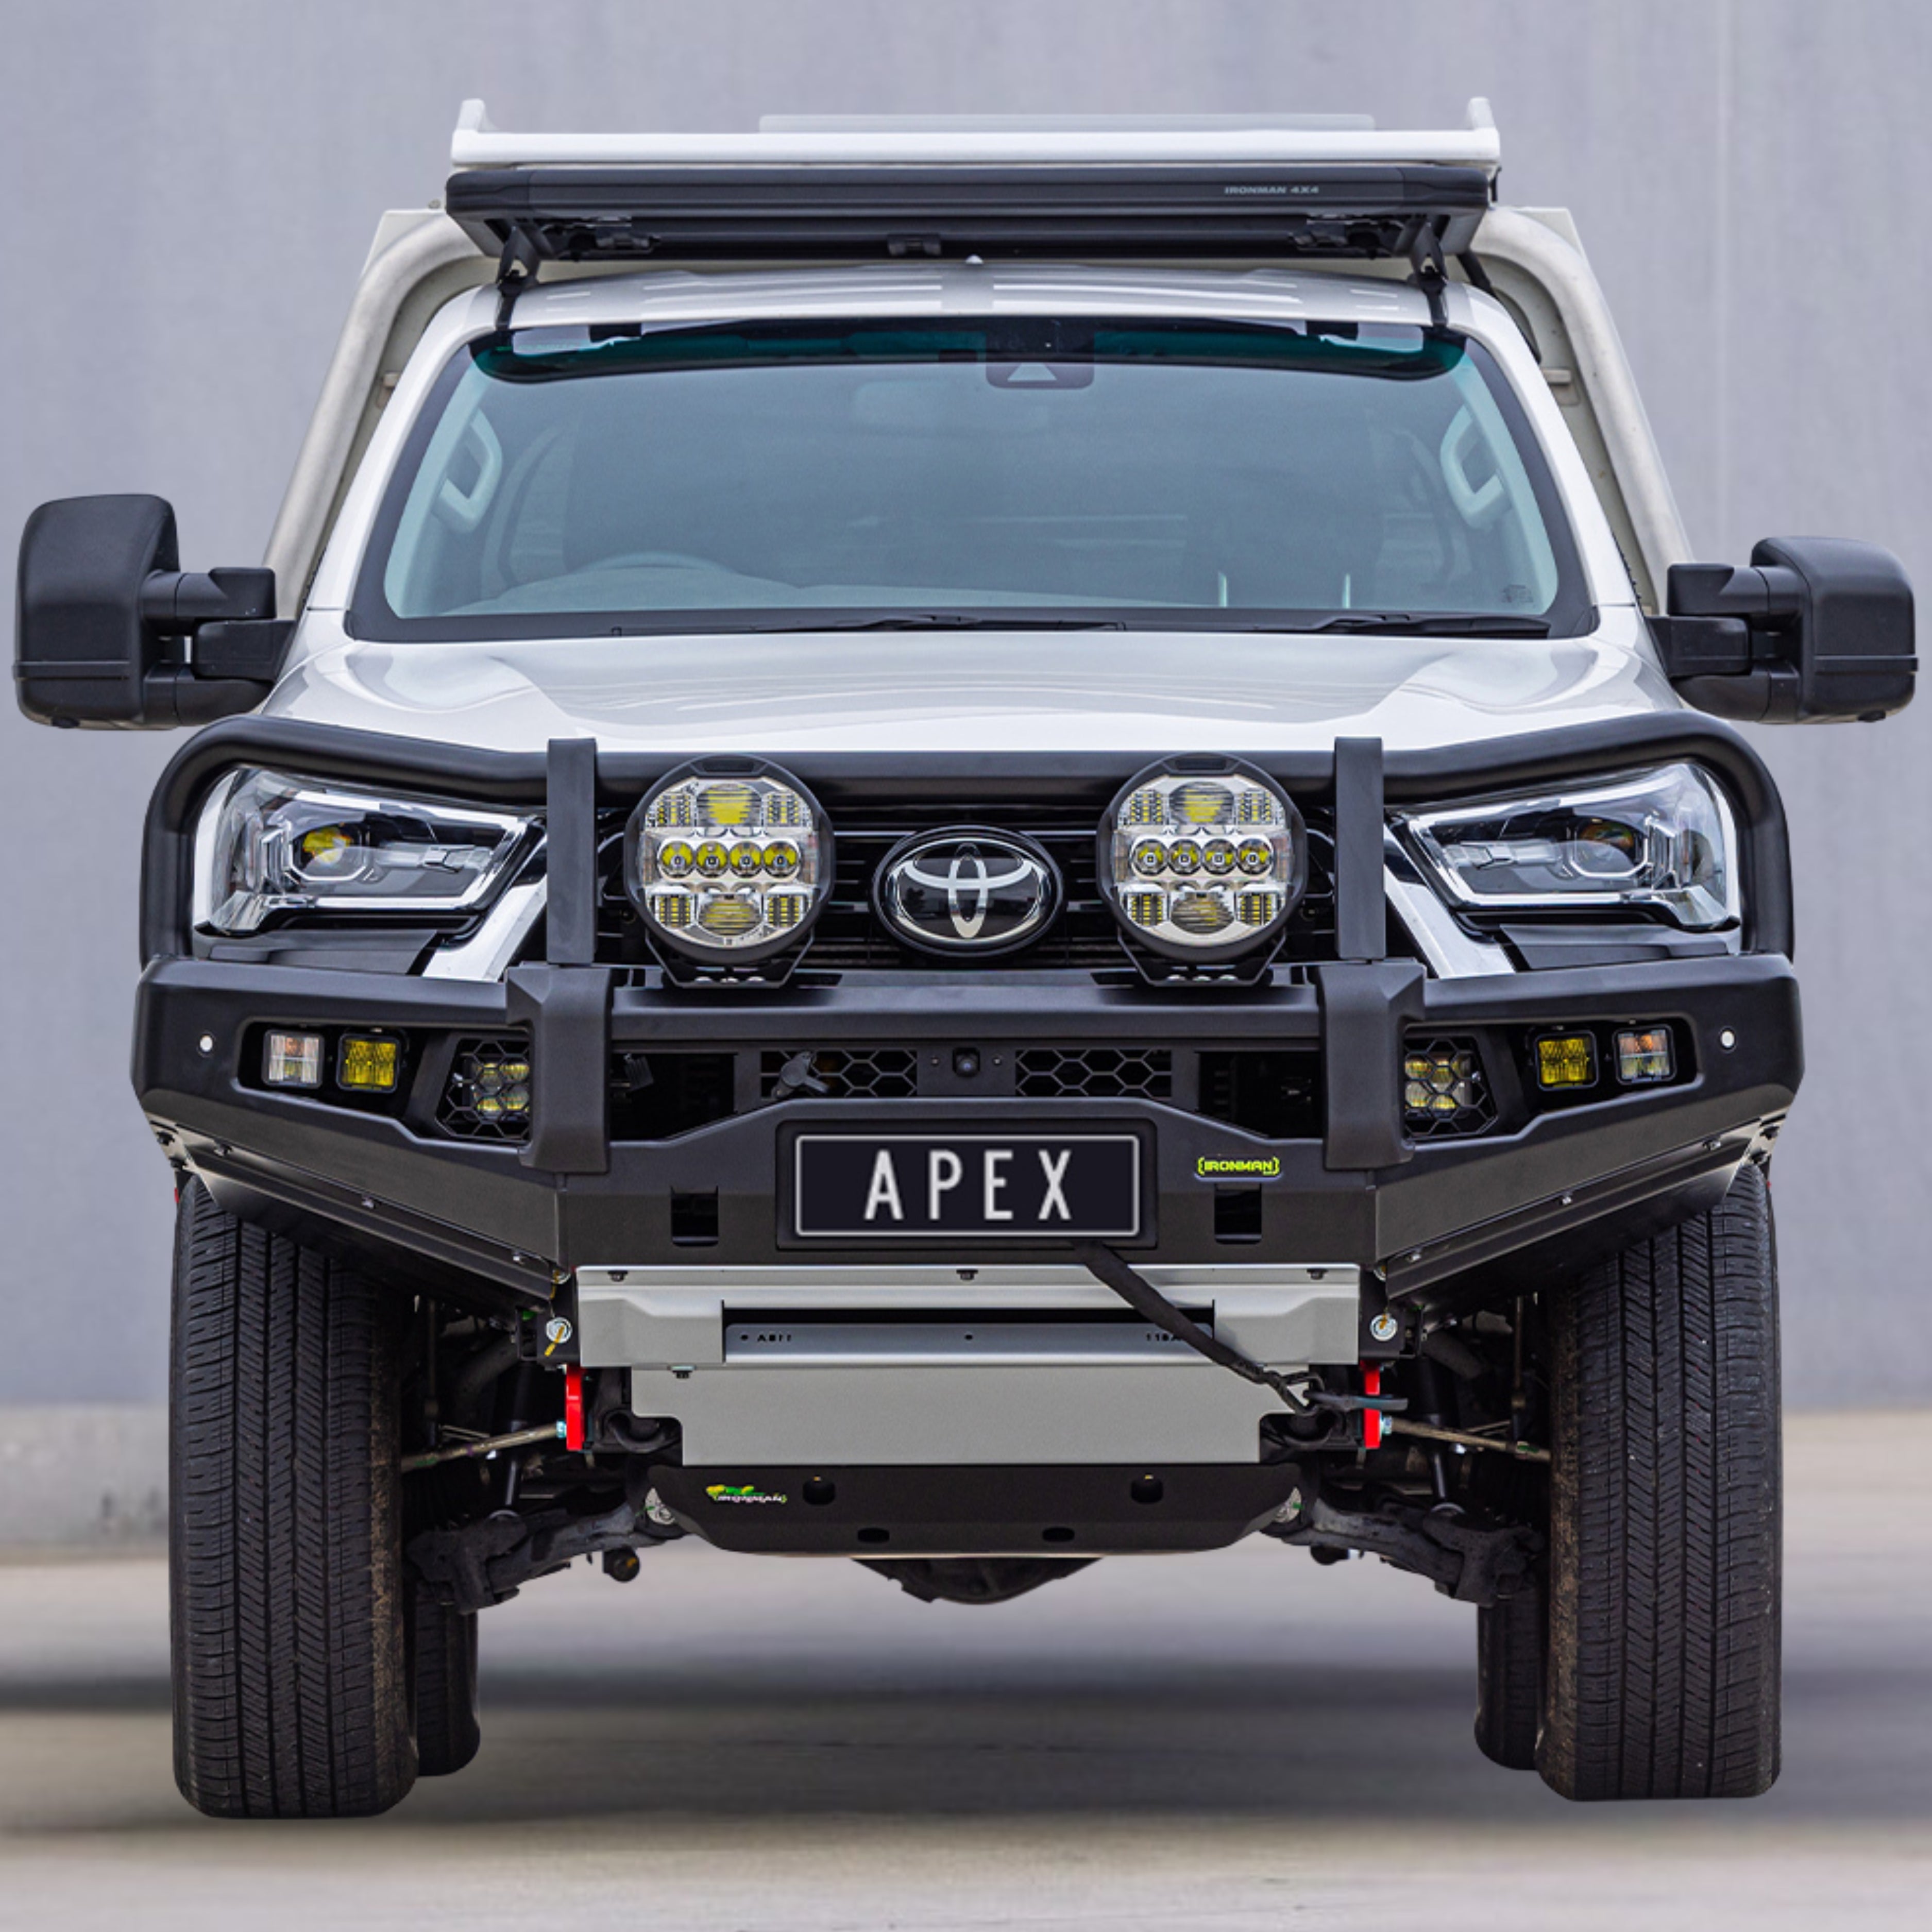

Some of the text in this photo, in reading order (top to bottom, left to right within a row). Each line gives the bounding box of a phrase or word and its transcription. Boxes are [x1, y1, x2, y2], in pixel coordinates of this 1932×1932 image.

[1224, 186, 1286, 194] IRONMAN
[1203, 1160, 1274, 1172] IRONMAN
[865, 1149, 1072, 1221] APEX
